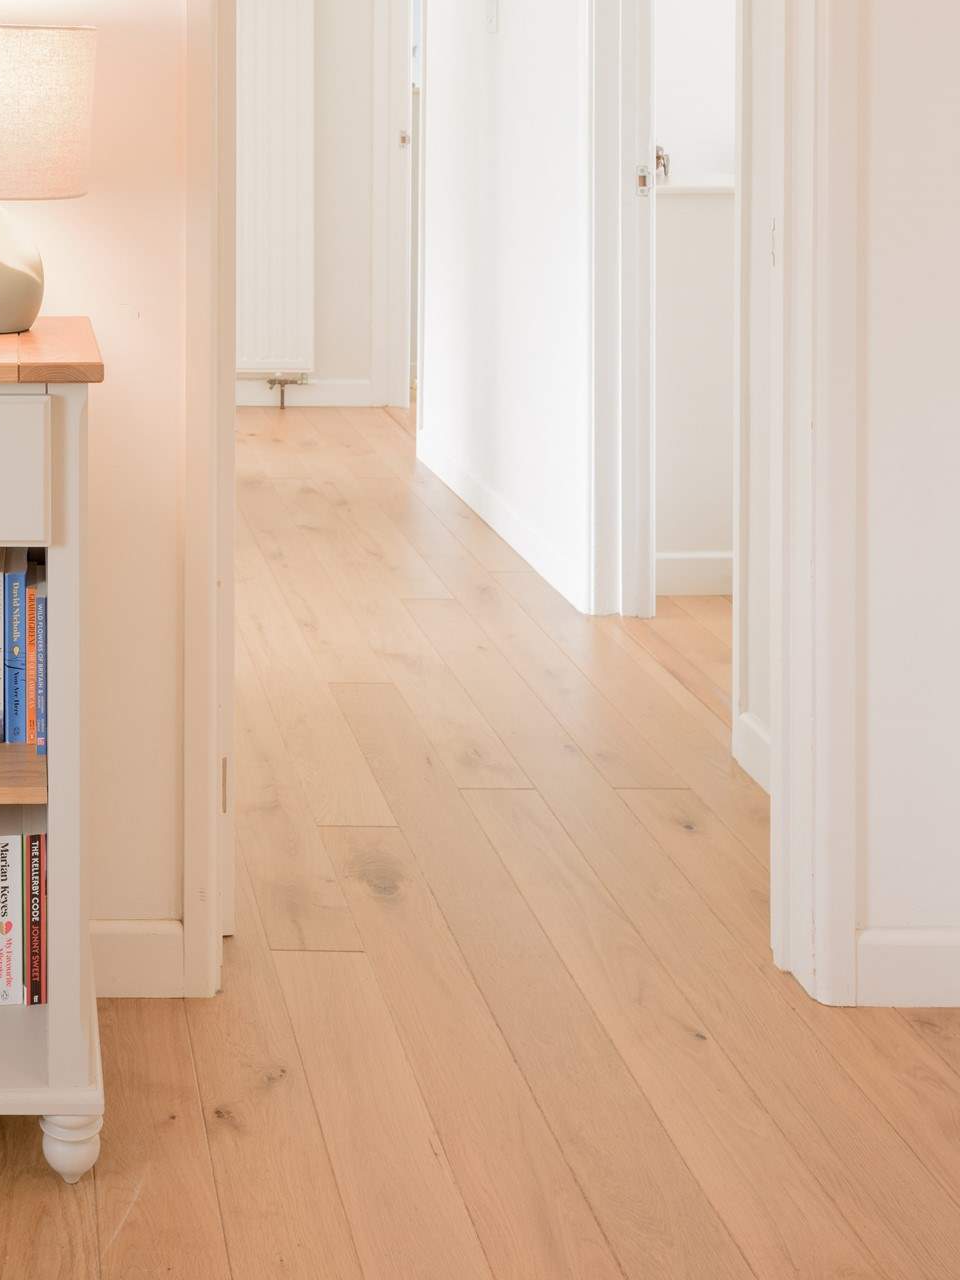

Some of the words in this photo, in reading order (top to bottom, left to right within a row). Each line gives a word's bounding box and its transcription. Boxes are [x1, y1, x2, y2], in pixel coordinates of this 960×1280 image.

[12, 582, 20, 607] David
[12, 609, 20, 641] Nicholls
[0, 842, 10, 882] Marian
[31, 841, 39, 856] THE
[31, 858, 39, 895] KELLERBY
[31, 897, 39, 922] CODE
